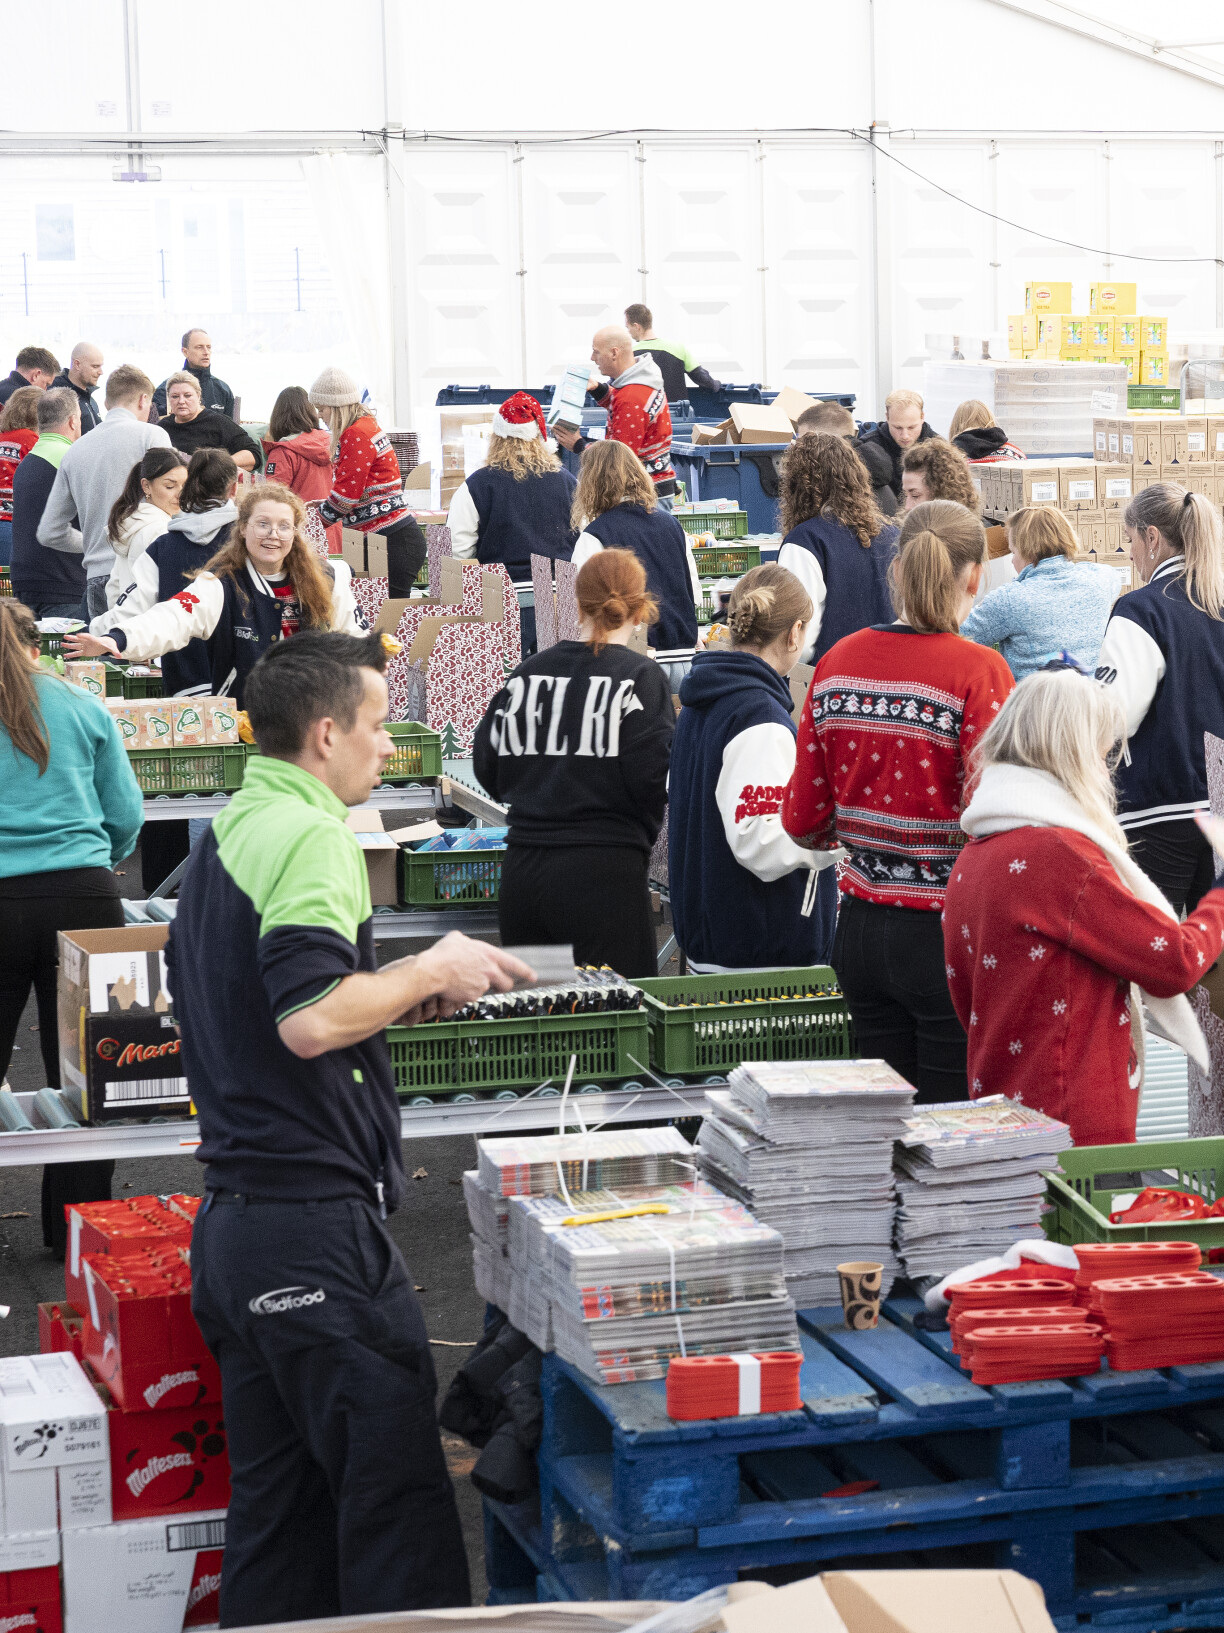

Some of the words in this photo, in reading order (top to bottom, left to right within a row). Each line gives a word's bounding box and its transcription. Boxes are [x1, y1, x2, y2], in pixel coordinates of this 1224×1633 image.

[116, 1039, 182, 1068] Mars
[263, 1288, 326, 1314] Bidfood
[126, 1452, 195, 1498] Maltesers
